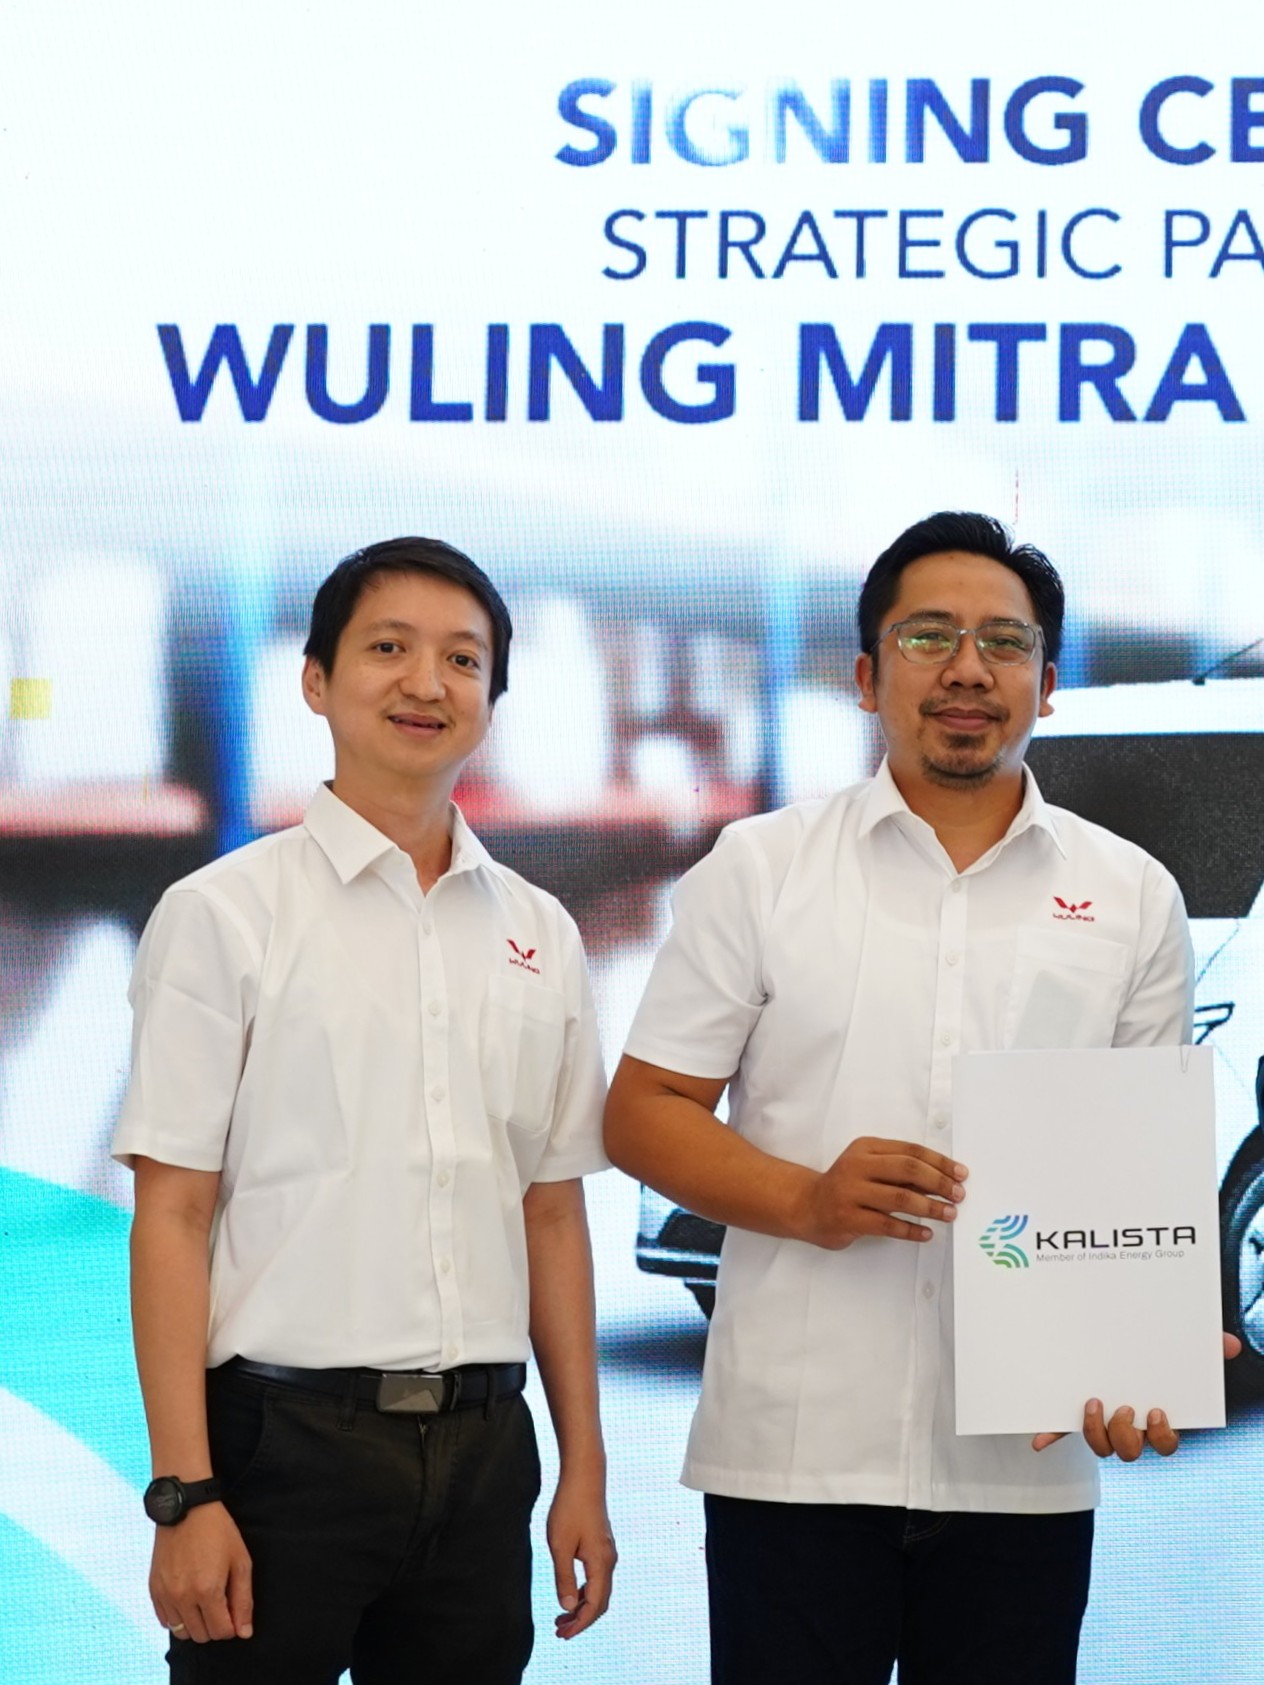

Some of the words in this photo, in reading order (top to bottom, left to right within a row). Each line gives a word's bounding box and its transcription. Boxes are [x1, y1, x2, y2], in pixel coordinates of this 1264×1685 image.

[554, 77, 1089, 167] SIGNING
[602, 208, 1122, 280] STRATEGIC
[157, 321, 737, 424] WULING
[798, 322, 1247, 423] MITRA
[1036, 1226, 1196, 1250] KALISTA
[1036, 1253, 1074, 1262] Member
[1077, 1252, 1087, 1261] of
[1089, 1251, 1117, 1260] Indika
[1120, 1250, 1152, 1261] Energy
[1155, 1249, 1185, 1259] Group
